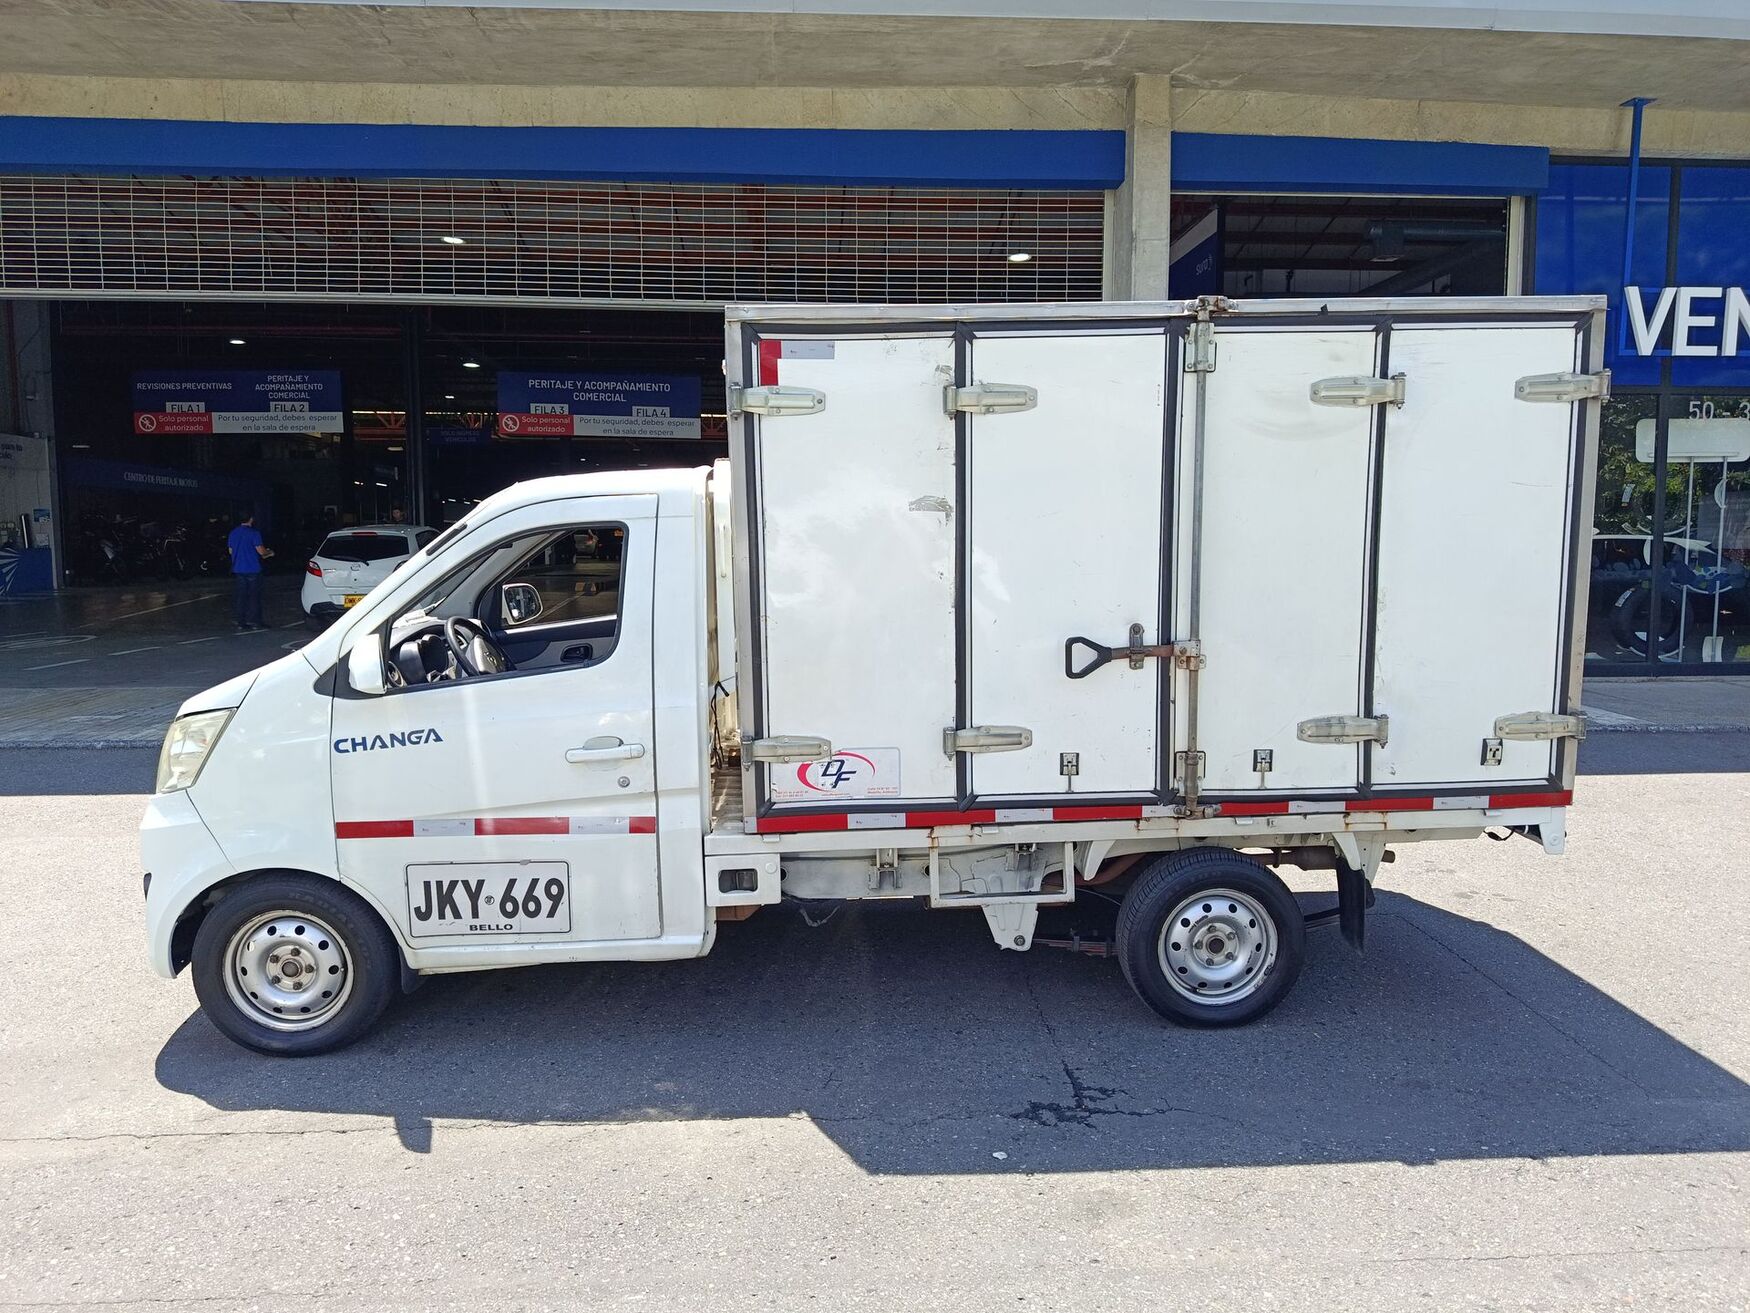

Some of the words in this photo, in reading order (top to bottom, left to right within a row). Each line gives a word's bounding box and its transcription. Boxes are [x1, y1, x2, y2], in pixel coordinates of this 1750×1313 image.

[267, 375, 303, 383] PERITAJE
[304, 375, 309, 383] Y
[136, 382, 180, 390] REVISIONES
[181, 382, 232, 390] PREVENTIVAS
[255, 382, 323, 391] ACOMPAÑAMIENTO
[528, 379, 574, 389] PERITAJE
[575, 380, 582, 389] Y
[584, 380, 671, 392] ACOMPAÑAMIENTO
[573, 392, 627, 402] COMERCIAL
[171, 404, 194, 413] FILA
[274, 404, 297, 413] FILA
[299, 404, 305, 413] 2
[534, 405, 557, 415] FILA
[559, 406, 565, 415] 3
[636, 408, 658, 418] FILA
[659, 408, 667, 418] 4
[1688, 401, 1714, 420] 50
[158, 414, 175, 422] Solo
[176, 414, 209, 424] personal
[218, 414, 230, 422] Por
[241, 414, 281, 424] seguridad,
[282, 414, 305, 422] debes
[308, 415, 337, 424] esperar
[521, 416, 538, 424] Solo
[539, 416, 571, 426] personal
[579, 417, 591, 425] Por
[601, 417, 641, 427] seguridad,
[641, 418, 664, 426] debes
[667, 419, 695, 429] esperar
[164, 423, 204, 431] autorizado
[261, 423, 278, 431] sala
[278, 423, 289, 431] de
[289, 424, 316, 433] espera
[527, 425, 566, 433] autorizado
[613, 426, 621, 434] la
[622, 427, 637, 435] sala
[638, 427, 647, 435] de
[649, 428, 674, 437] espera
[333, 728, 444, 754] CHANGA
[821, 759, 857, 788] DF
[413, 879, 486, 921] JKY
[499, 877, 565, 919] 669
[469, 923, 513, 932] BELLO
